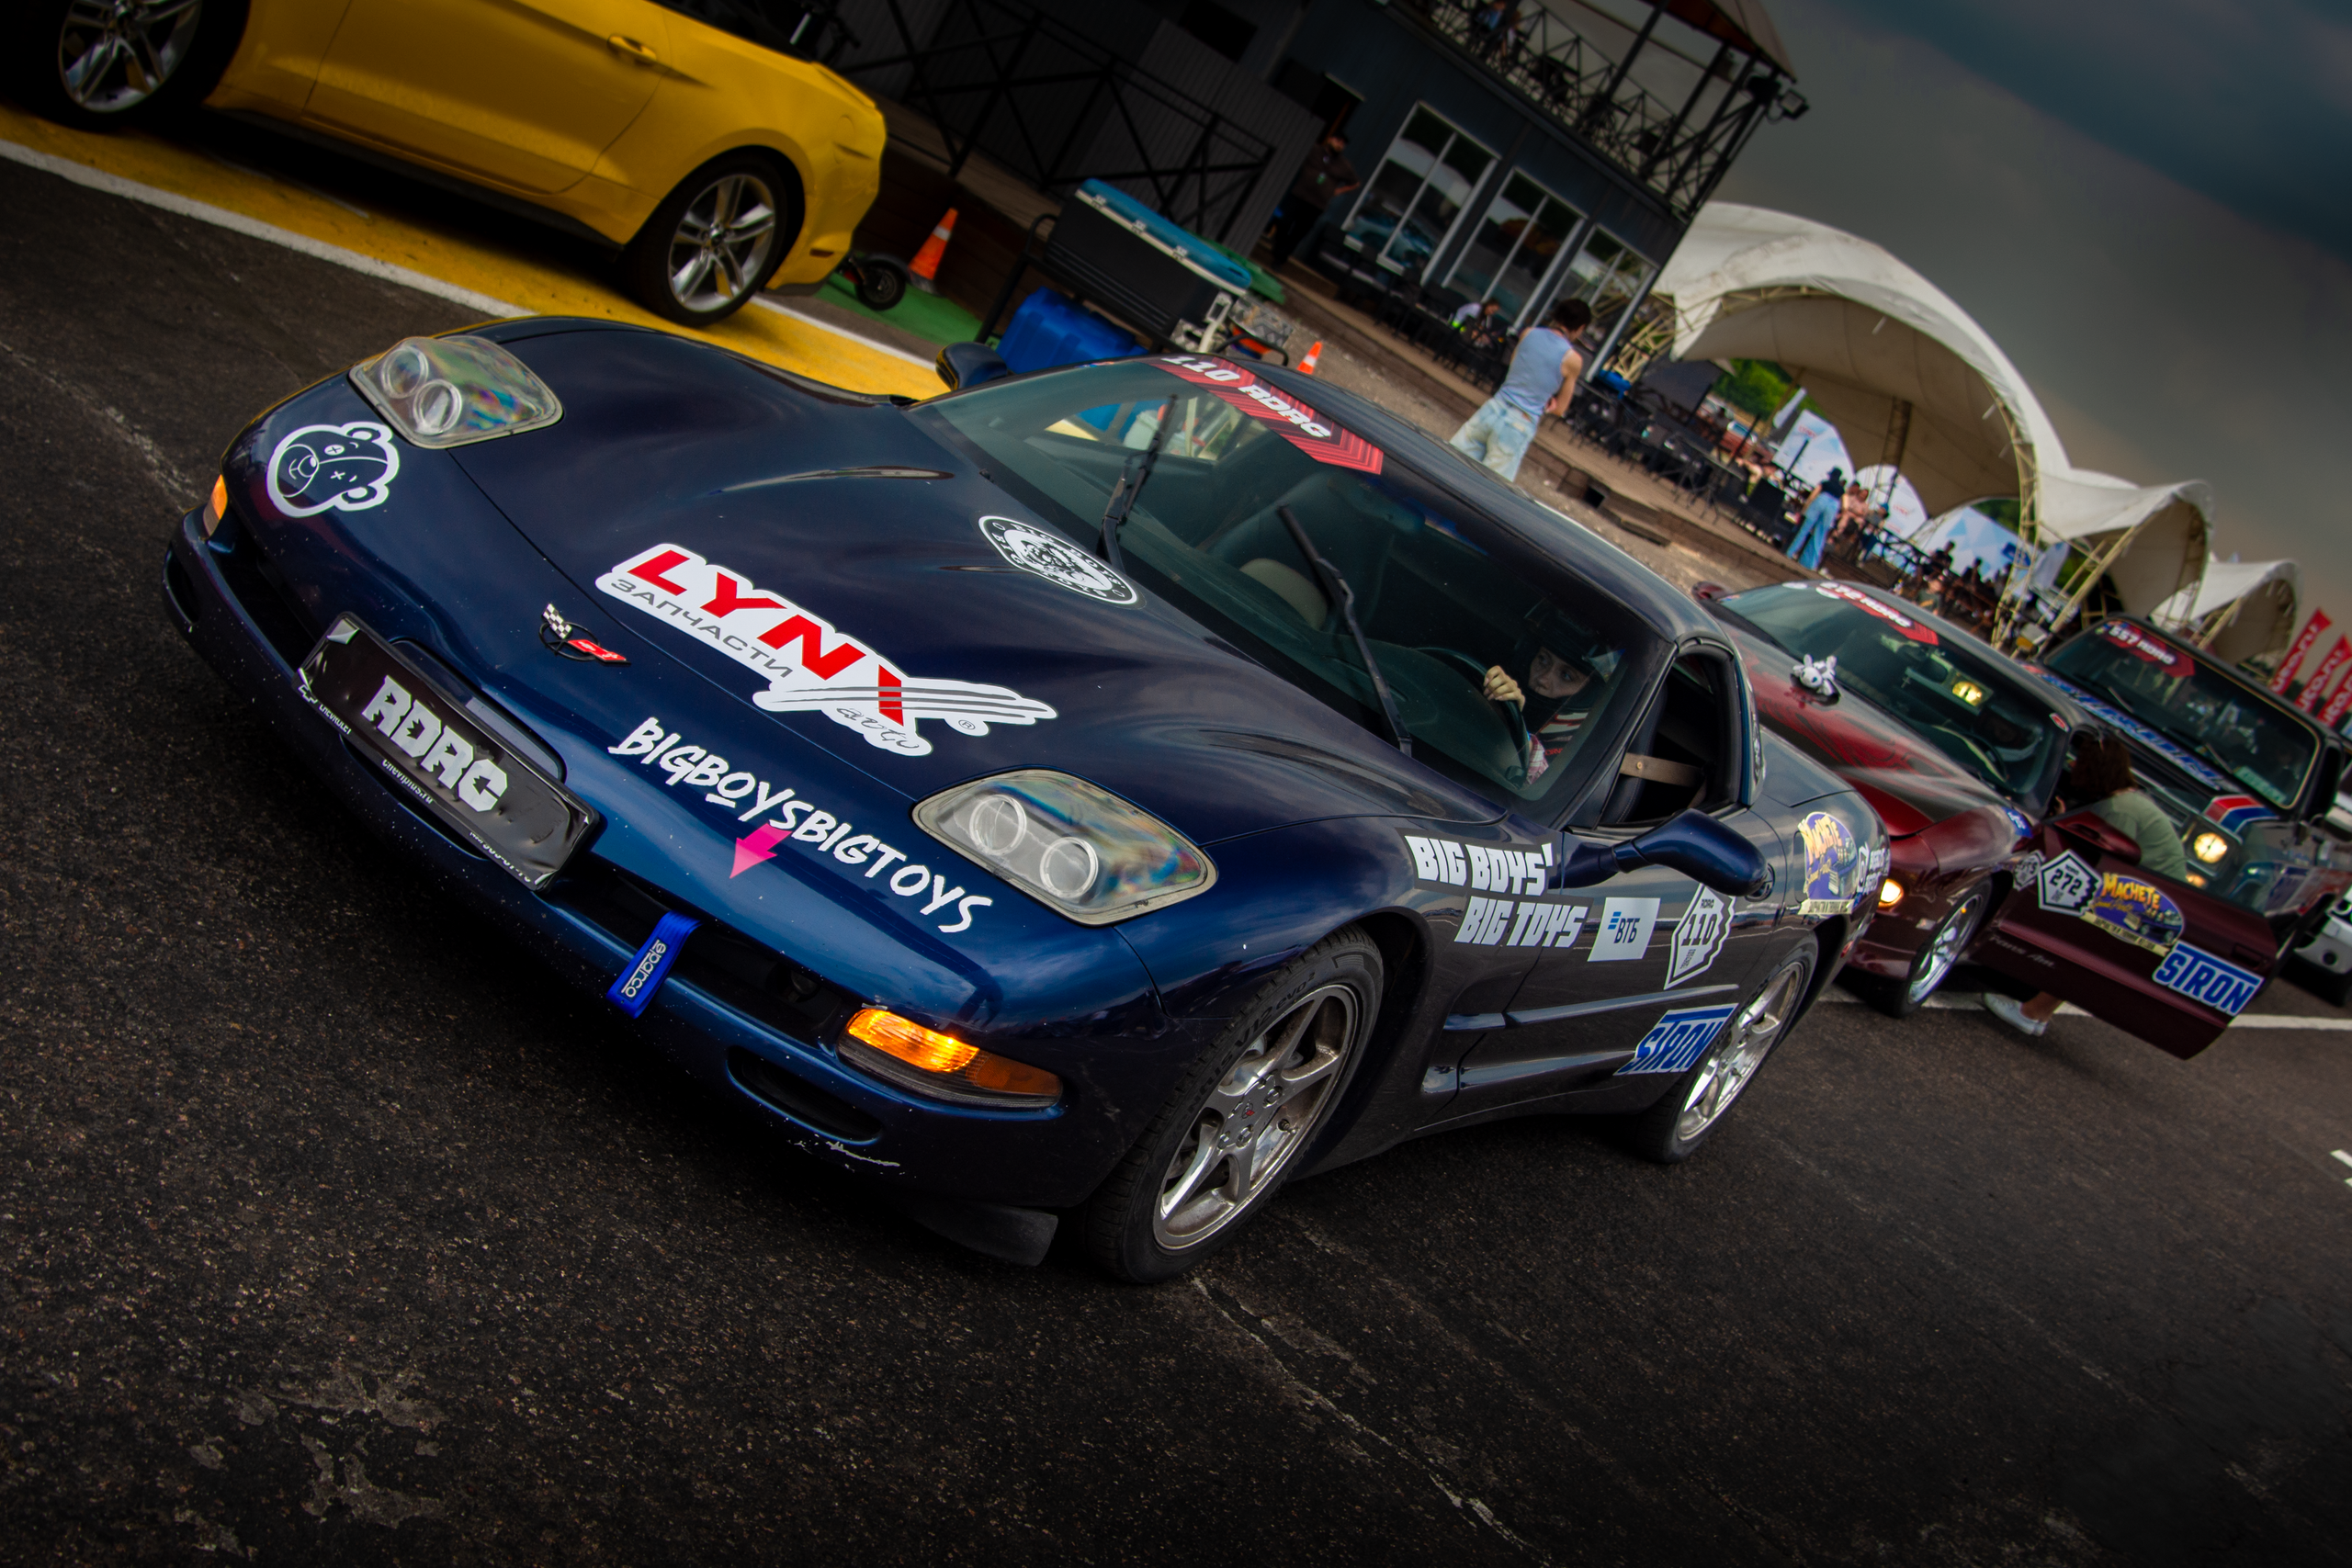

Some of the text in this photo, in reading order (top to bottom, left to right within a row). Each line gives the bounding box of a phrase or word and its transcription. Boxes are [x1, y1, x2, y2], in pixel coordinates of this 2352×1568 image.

[1160, 355, 1331, 438] 110 RDRC
[991, 532, 1024, 565] BIG
[1010, 523, 1055, 543] BIG
[611, 578, 793, 678] ЗАПЧАСТИ
[628, 549, 904, 727] LYNX
[362, 675, 507, 812] RDRC
[836, 707, 921, 750] auto
[1404, 835, 1467, 886] BIG
[2050, 868, 2084, 897] 272
[2099, 872, 2161, 909] MACHETE
[1453, 896, 1589, 948] BIG TOYS
[1613, 918, 1641, 944] ВТБ
[1681, 914, 1718, 946] 110
